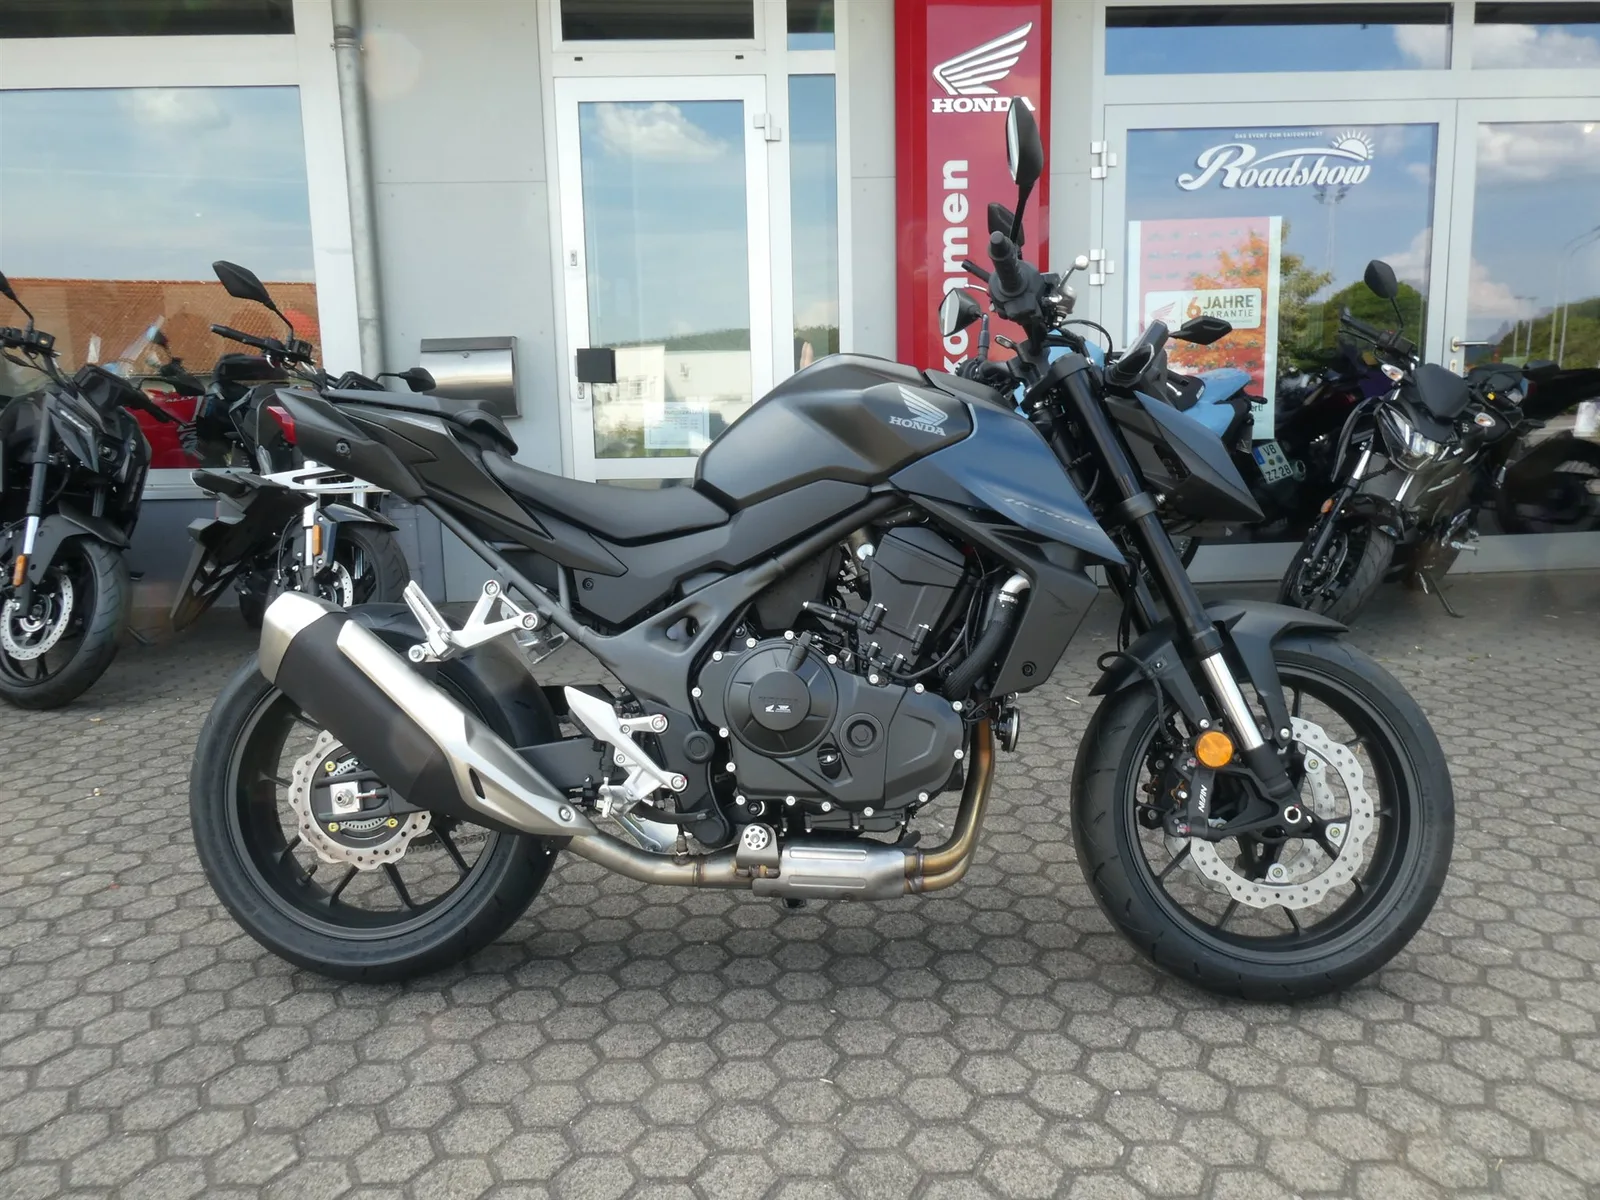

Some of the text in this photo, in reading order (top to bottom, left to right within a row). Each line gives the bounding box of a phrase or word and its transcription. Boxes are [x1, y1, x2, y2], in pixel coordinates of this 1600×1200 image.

[1178, 143, 1371, 191] Roadshow
[1187, 295, 1254, 319] 6 JAHRE
[1202, 309, 1253, 318] GARANTIE
[889, 415, 946, 436] HONDA
[1262, 444, 1277, 456] VB
[1265, 469, 1280, 482] ZZ
